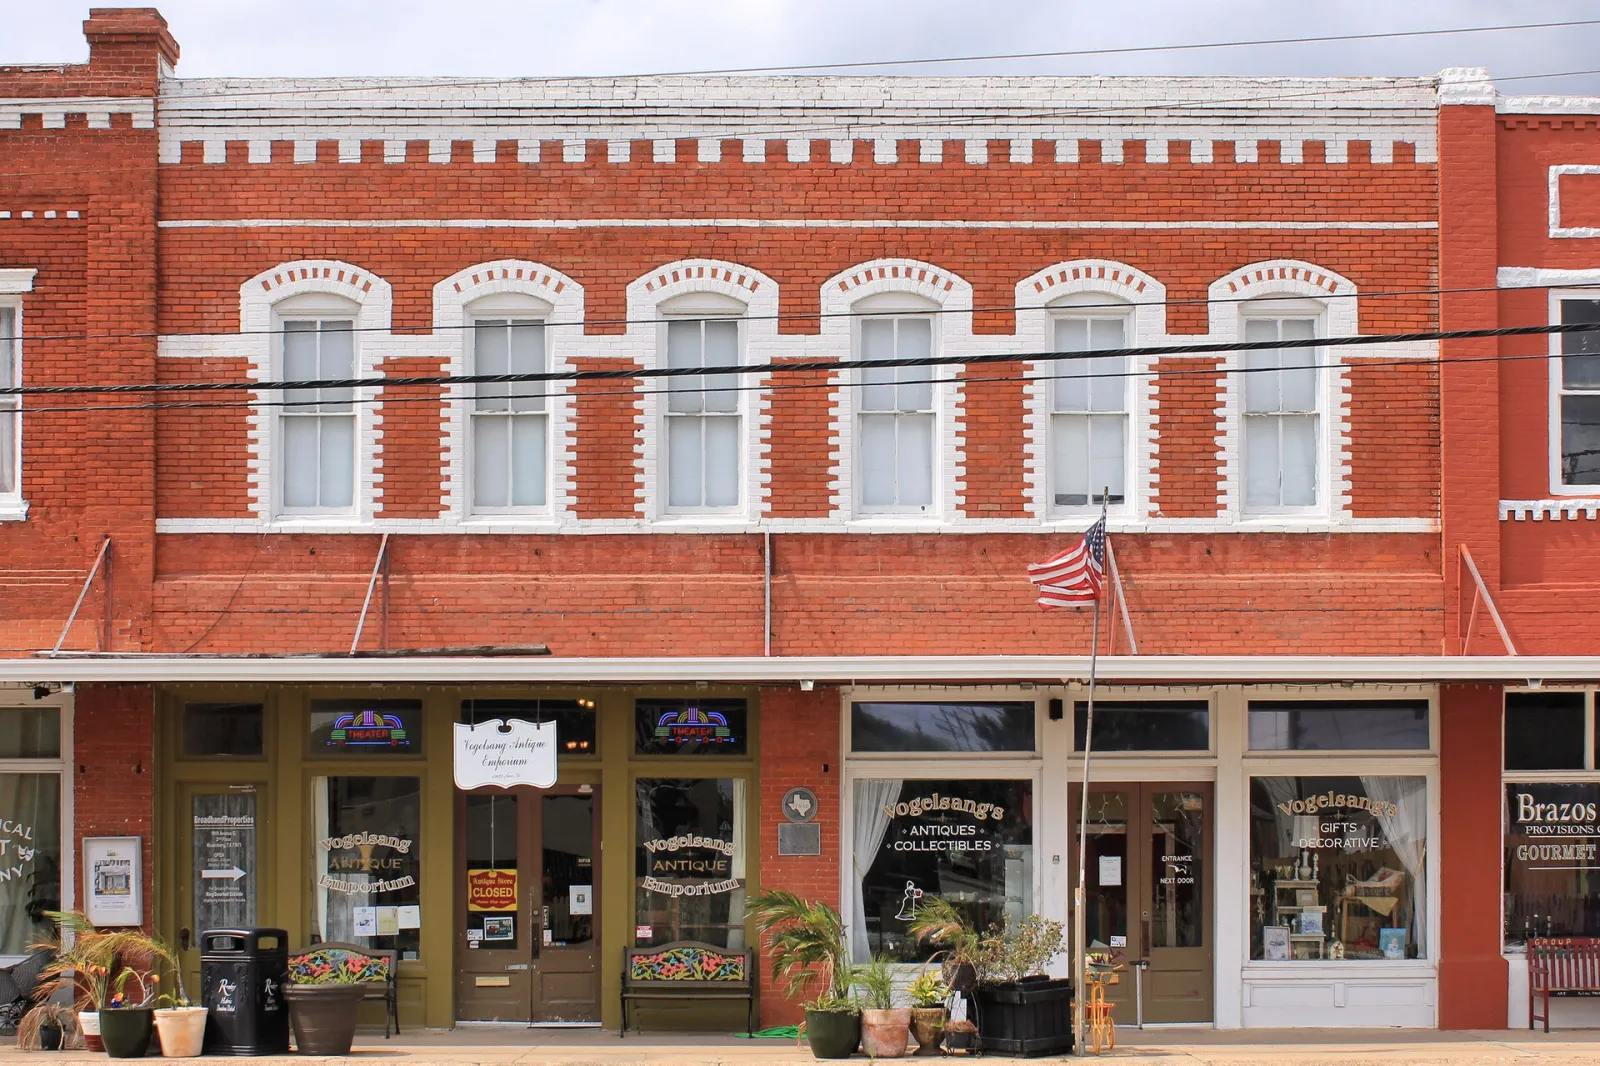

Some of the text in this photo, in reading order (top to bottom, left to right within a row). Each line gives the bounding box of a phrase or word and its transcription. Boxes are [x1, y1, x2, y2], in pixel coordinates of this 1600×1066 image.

[348, 730, 389, 738] THEATER
[672, 727, 713, 735] THEATER
[464, 737, 547, 755] Vogelsang Antique
[482, 754, 528, 771] Emporium
[883, 793, 1005, 820] Vogelsang's
[1277, 791, 1398, 816] Vogelsang's
[1516, 793, 1597, 823] Brazos
[910, 825, 976, 836] ANTIQUES
[1320, 822, 1357, 833] GIFTS
[1525, 825, 1594, 834] PROVISIONS
[319, 831, 412, 853] Vogelsang
[644, 833, 737, 856] Vogelsang
[894, 840, 992, 851] COLLECTIBLES
[1299, 838, 1379, 848] DECORATIVE
[1516, 844, 1596, 861] GOURMET
[329, 856, 404, 870] ANTQUE
[653, 860, 728, 872] ANTIQUE
[318, 874, 416, 895] Emporium
[473, 877, 513, 886] Antique Store
[641, 876, 740, 898] Emporium
[473, 887, 513, 898] CLOSED
[1534, 938, 1572, 946] GROUP
